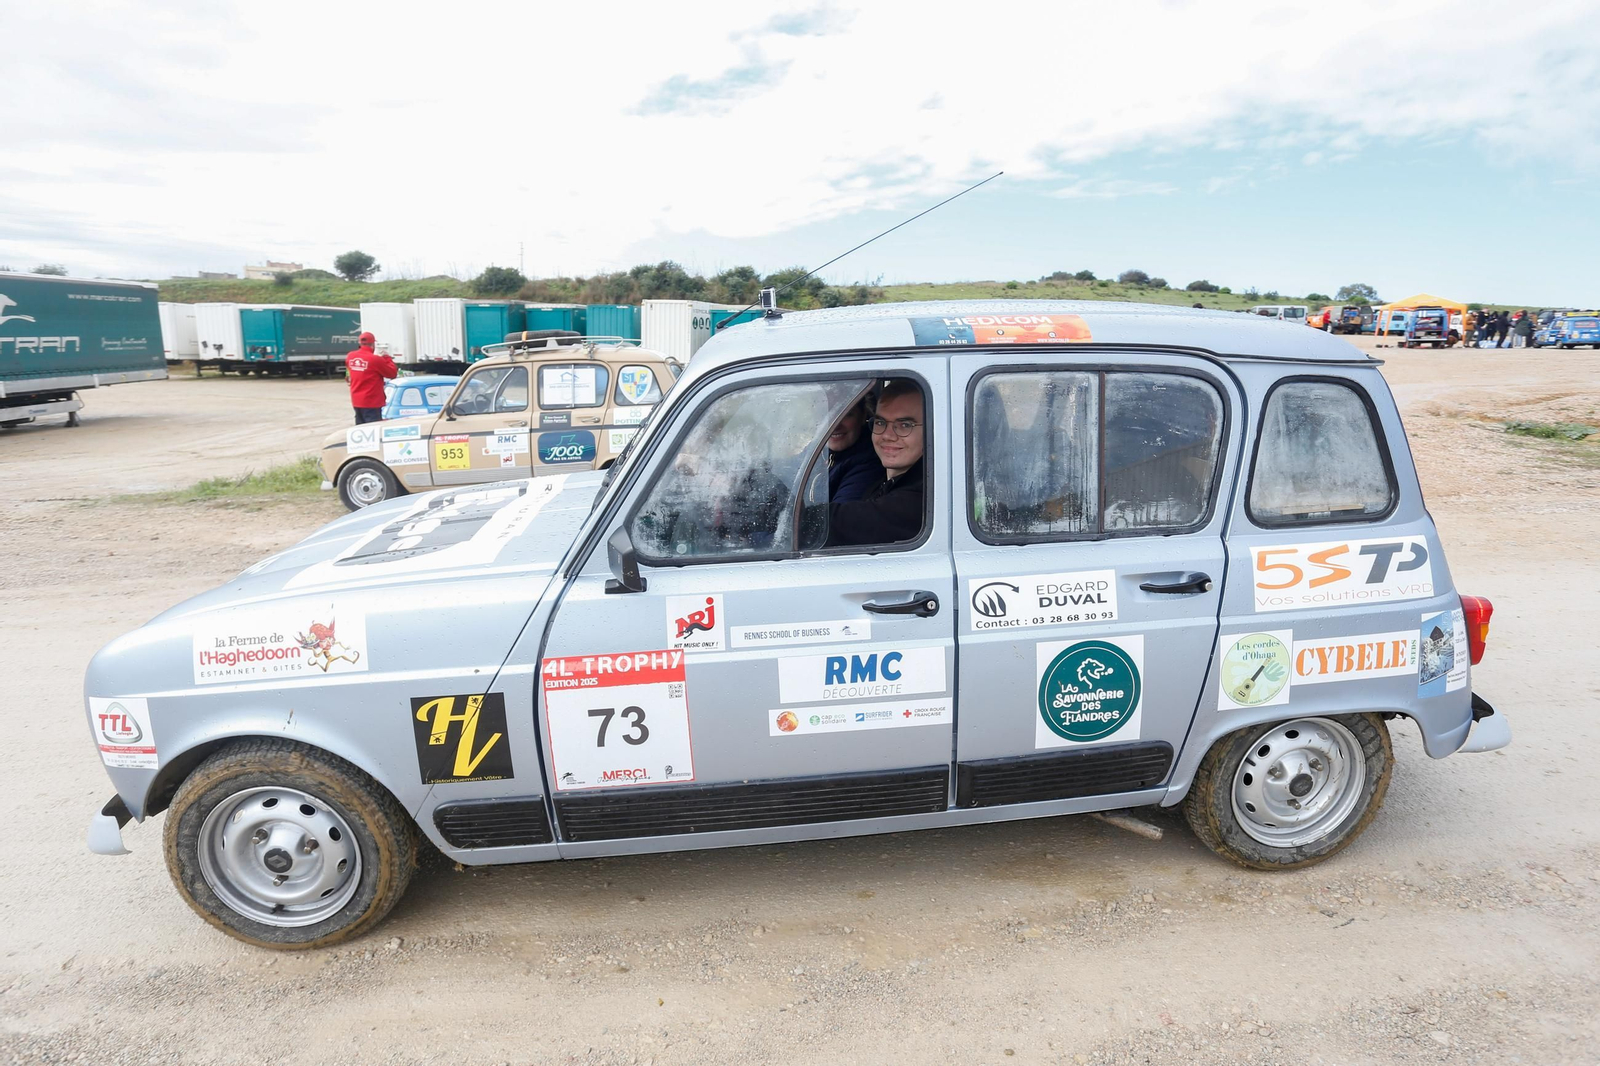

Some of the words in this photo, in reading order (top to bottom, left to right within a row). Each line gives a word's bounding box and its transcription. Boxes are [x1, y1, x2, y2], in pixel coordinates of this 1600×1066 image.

[943, 316, 1053, 326] HEDICOM
[498, 435, 517, 443] RMC
[441, 448, 463, 459] 953
[545, 446, 584, 460] JOOS
[1036, 581, 1109, 595] EDGARD
[1256, 596, 1294, 606] Vos
[1302, 589, 1391, 604] solutions
[1397, 583, 1432, 595] VRD
[1039, 593, 1108, 608] DUVAL
[675, 597, 715, 638] NRJ
[976, 618, 1020, 629] Contact
[1101, 611, 1114, 619] 93
[215, 637, 226, 648] la
[228, 635, 267, 646] Ferme
[269, 632, 284, 643] de
[744, 631, 768, 640] RENNES
[769, 630, 792, 639] SCHOOL
[793, 629, 800, 637] OF
[802, 628, 830, 637] BUSINESS
[1236, 642, 1250, 650] Les
[1253, 639, 1280, 649] cordes
[1242, 651, 1276, 661] d'Ohana
[1296, 639, 1407, 677] CYBELE
[544, 659, 574, 677] 4L
[582, 651, 683, 675] TROPHY
[825, 651, 903, 685] RMC
[200, 667, 255, 678] ESTAMINET
[545, 679, 578, 689] ÉDITION
[580, 677, 599, 686] 2025
[1061, 684, 1078, 693] LA
[823, 684, 902, 699] DÉCOUVERTE
[865, 711, 893, 719] SURFRIDER
[98, 714, 131, 731] TTL
[587, 705, 650, 747] 73
[603, 768, 647, 779] MERCI
